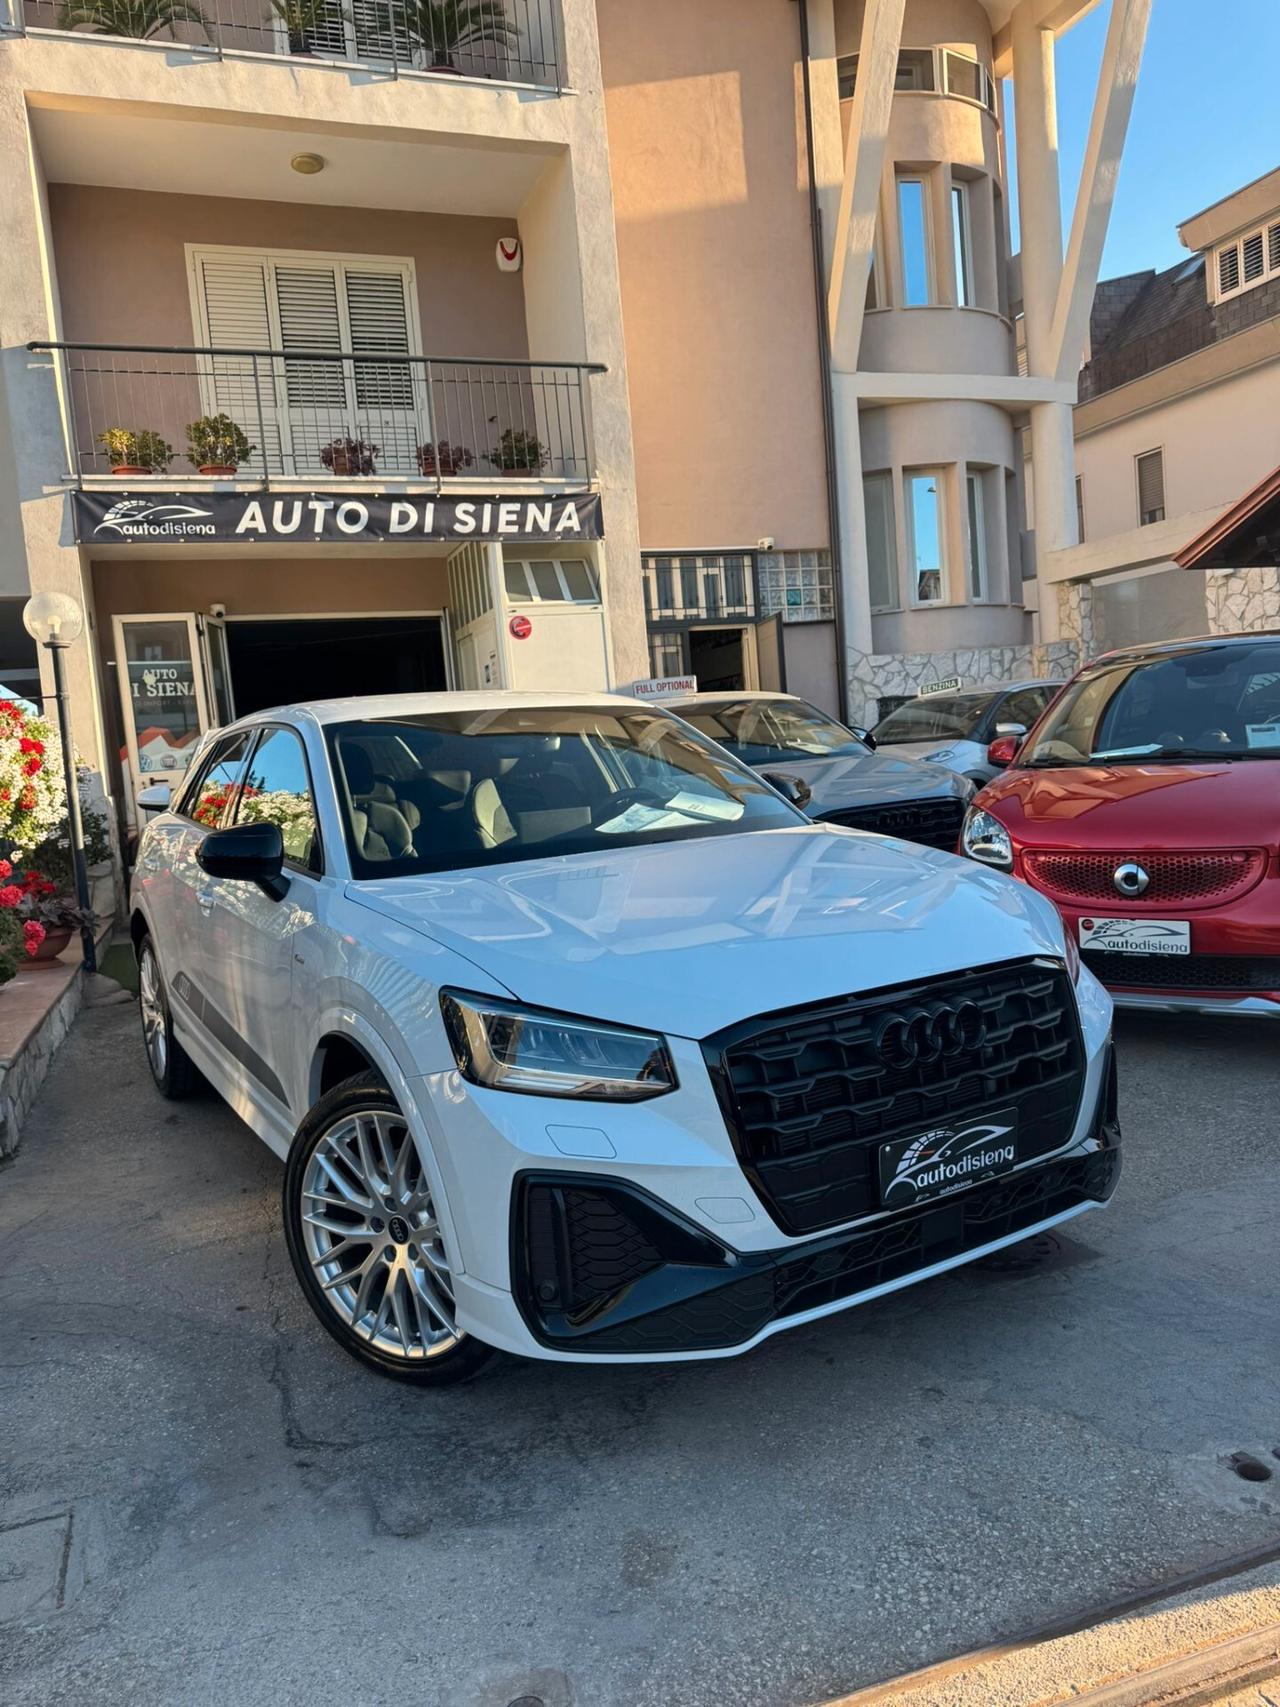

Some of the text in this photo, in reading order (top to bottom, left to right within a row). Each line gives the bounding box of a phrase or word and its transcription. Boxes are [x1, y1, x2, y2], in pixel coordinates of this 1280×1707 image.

[235, 501, 581, 534] AUTO DI SIENA
[123, 521, 215, 536] autodisiena
[635, 680, 694, 694] FULL OPTIONAL
[922, 680, 957, 694] BENZINA
[1107, 940, 1188, 953] autodisiena
[917, 1145, 1015, 1188] autodisiena
